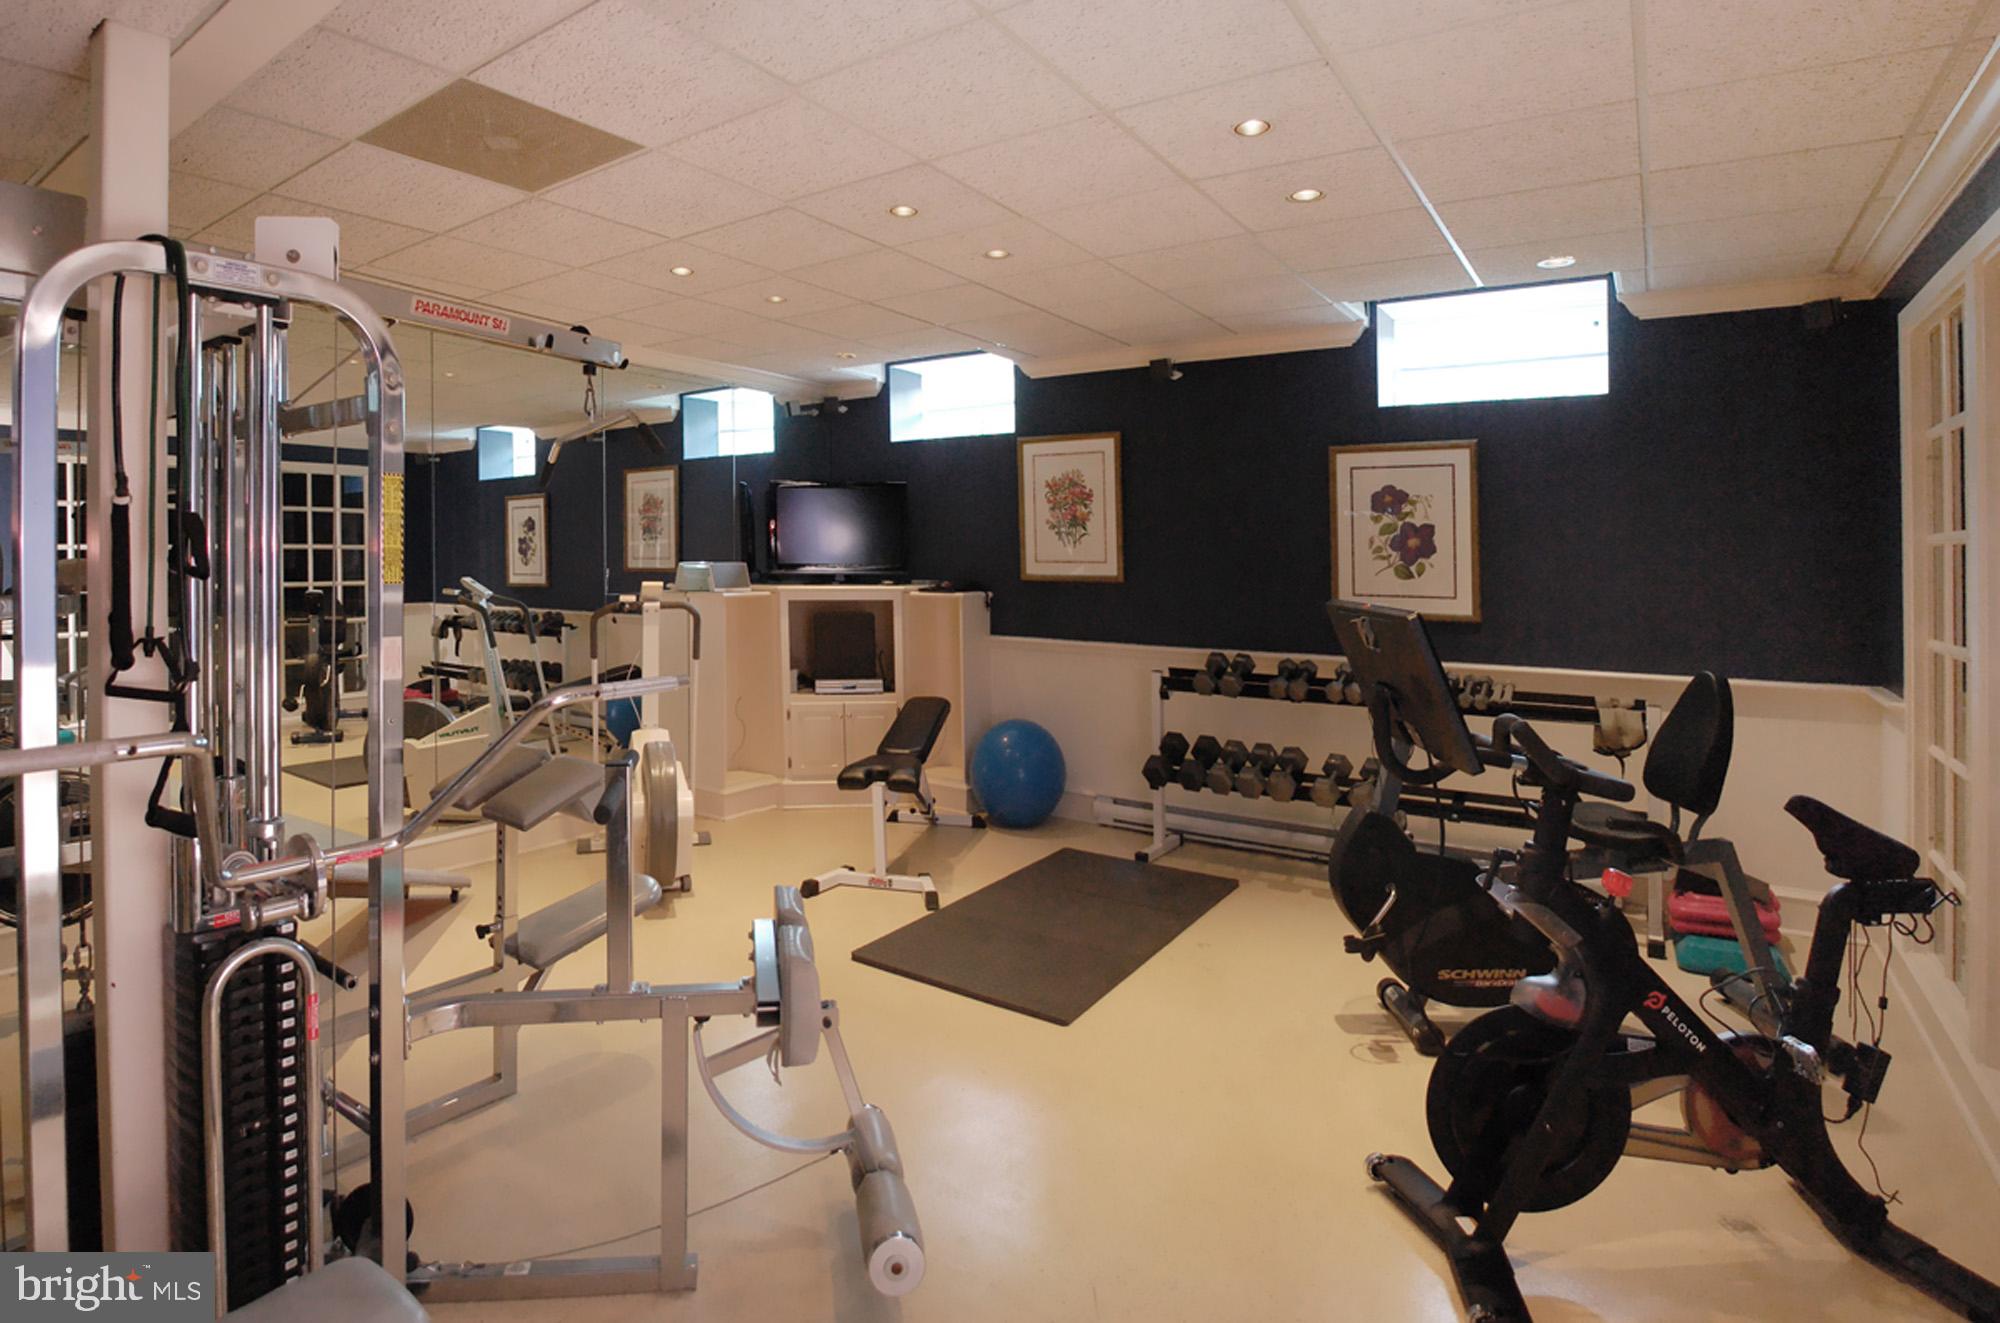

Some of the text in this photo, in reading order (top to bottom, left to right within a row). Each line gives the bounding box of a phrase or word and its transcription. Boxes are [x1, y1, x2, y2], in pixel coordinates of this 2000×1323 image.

[414, 299, 491, 326] PARAMOUNT
[1438, 968, 1527, 980] SCHWINN
[1660, 1005, 1708, 1053] PELOTON
